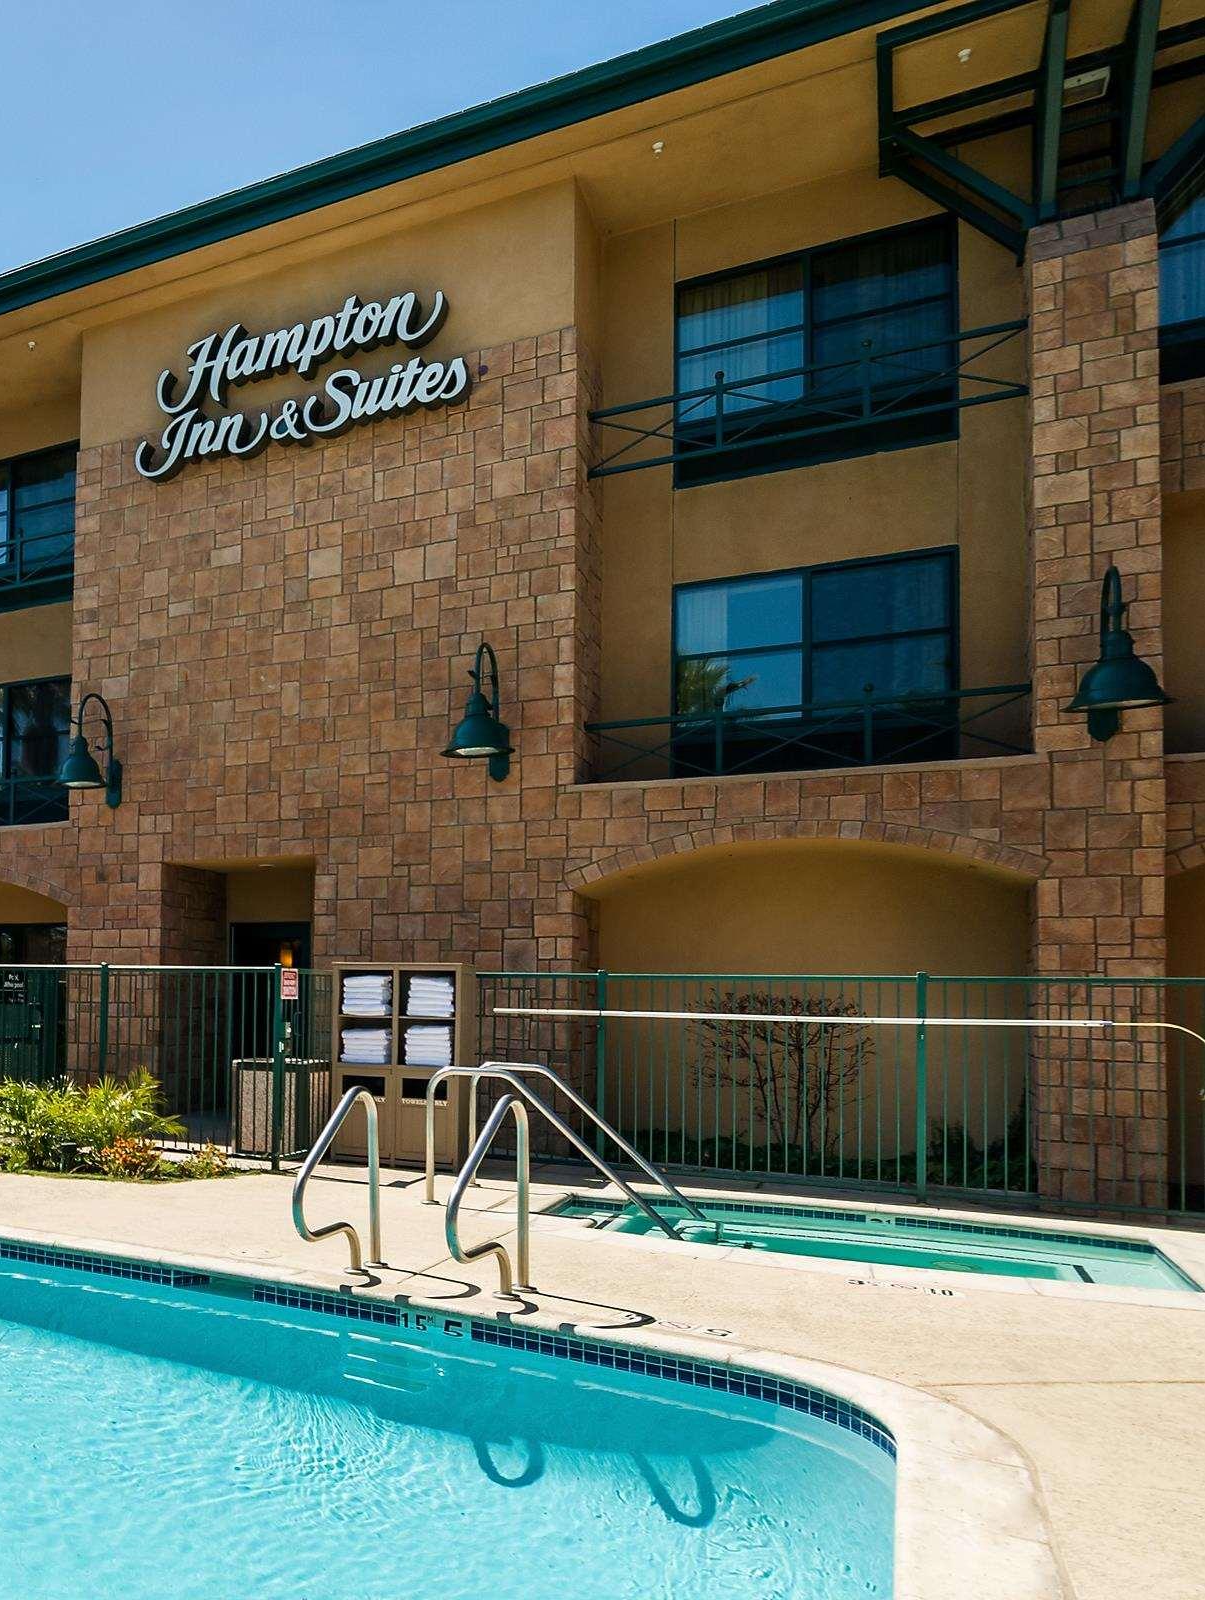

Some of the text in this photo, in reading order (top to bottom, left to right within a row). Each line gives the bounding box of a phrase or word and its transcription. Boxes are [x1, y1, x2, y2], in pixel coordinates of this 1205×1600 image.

[155, 289, 446, 415] Hampton
[134, 355, 469, 478] Inn & Suites
[443, 1319, 465, 1338] 5
